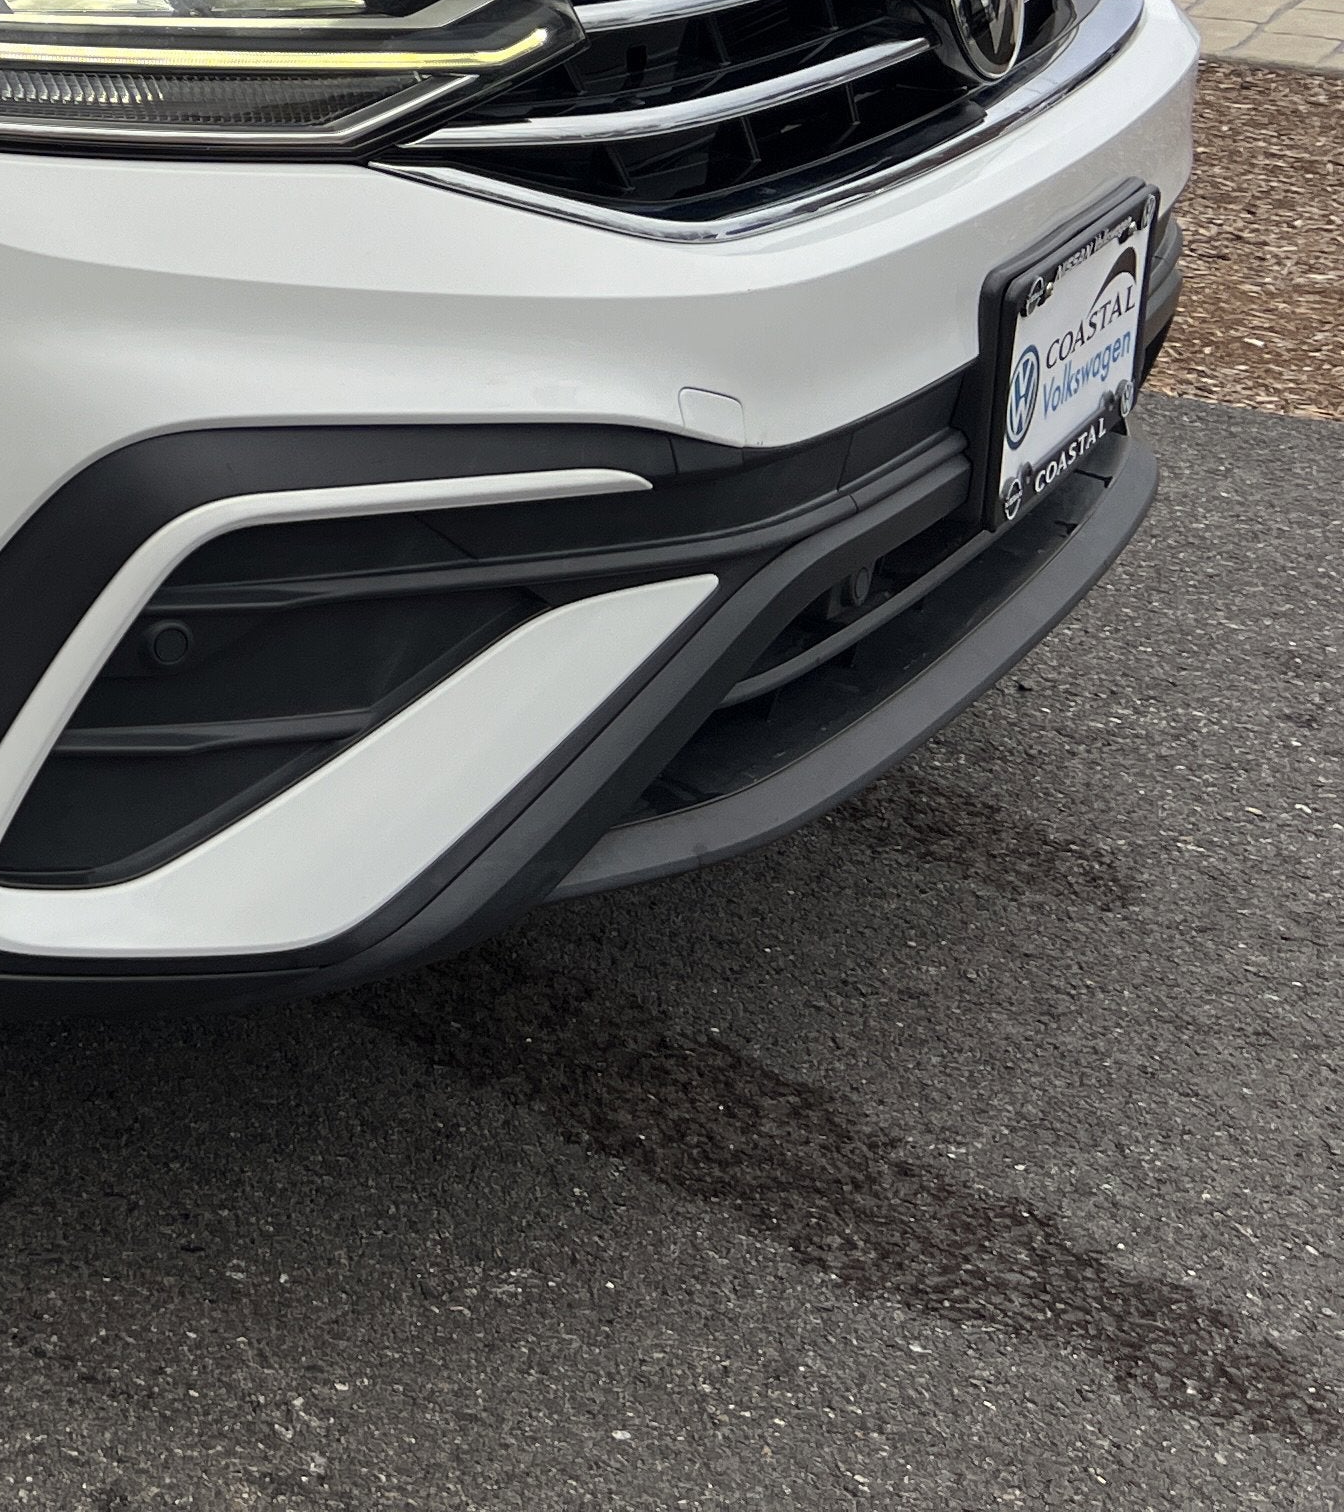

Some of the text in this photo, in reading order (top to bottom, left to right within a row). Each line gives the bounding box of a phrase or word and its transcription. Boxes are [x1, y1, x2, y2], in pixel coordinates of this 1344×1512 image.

[1045, 284, 1136, 369] COASTAL
[1042, 330, 1132, 421] Volkswagen
[1034, 417, 1107, 493] COASTAL
